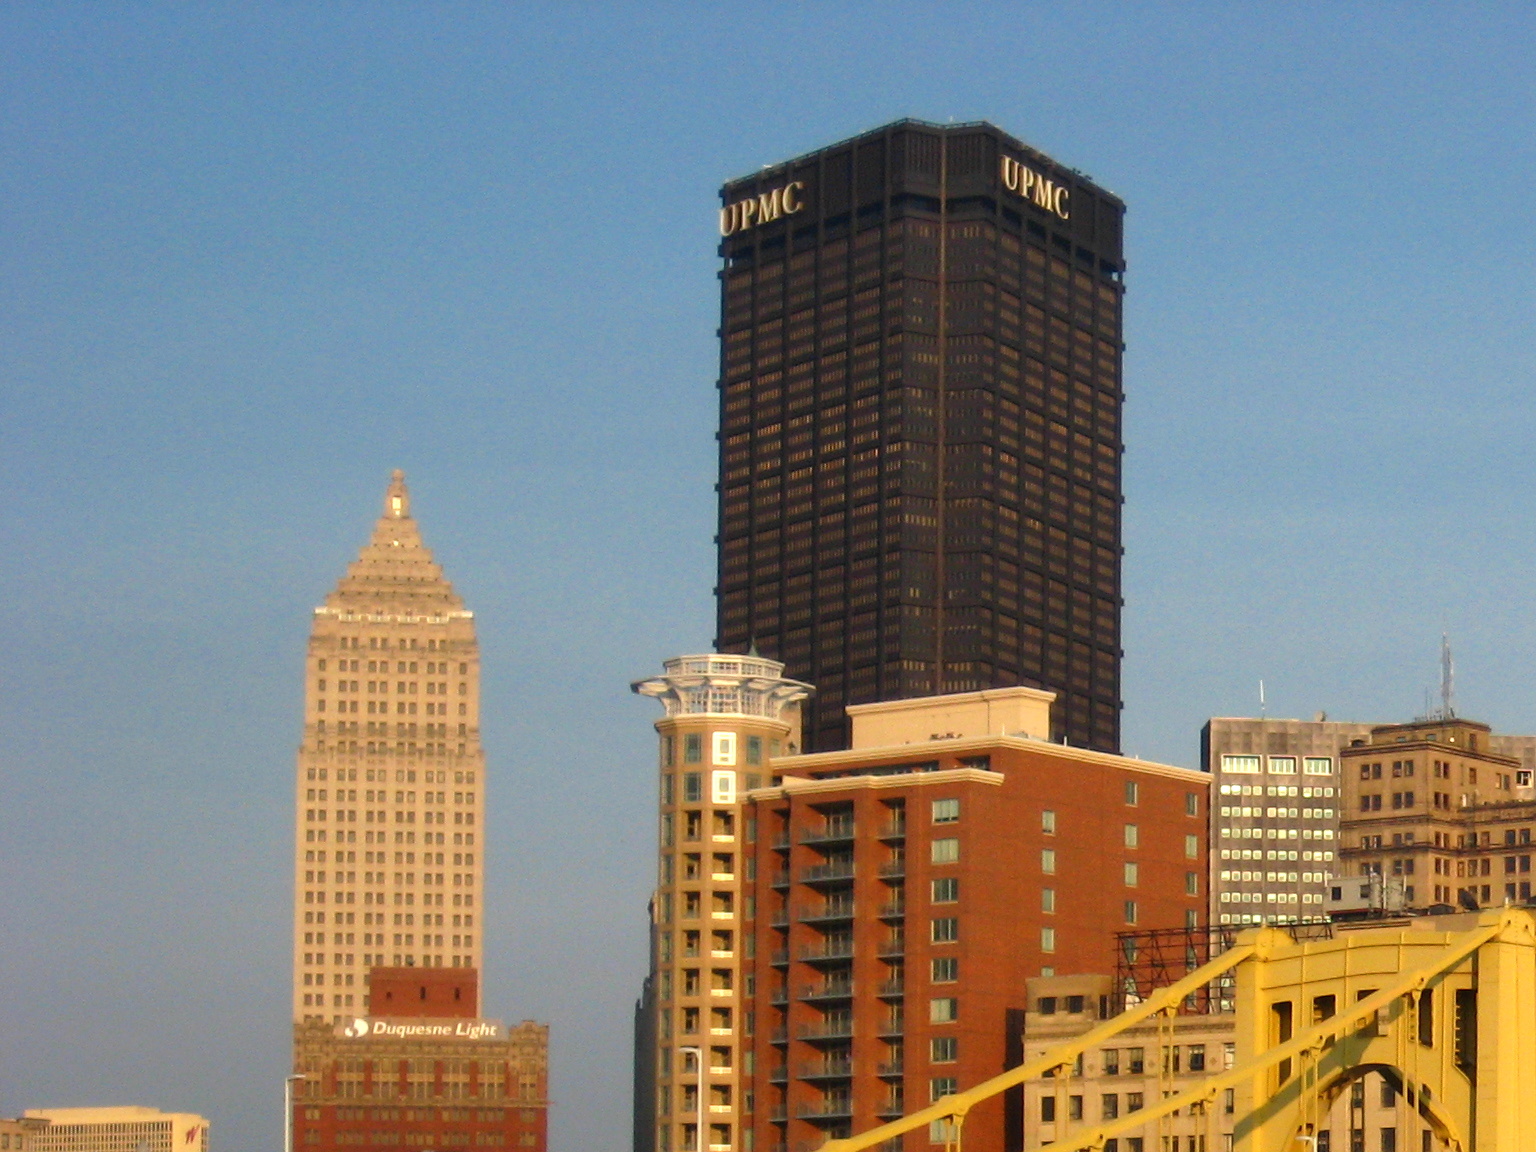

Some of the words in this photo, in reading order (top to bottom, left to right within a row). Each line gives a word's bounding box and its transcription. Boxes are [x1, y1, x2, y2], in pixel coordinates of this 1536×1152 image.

[719, 181, 804, 236] UPMC
[1001, 155, 1070, 220] UPMC
[373, 1021, 451, 1038] Duquesne
[455, 1022, 497, 1039] Light
